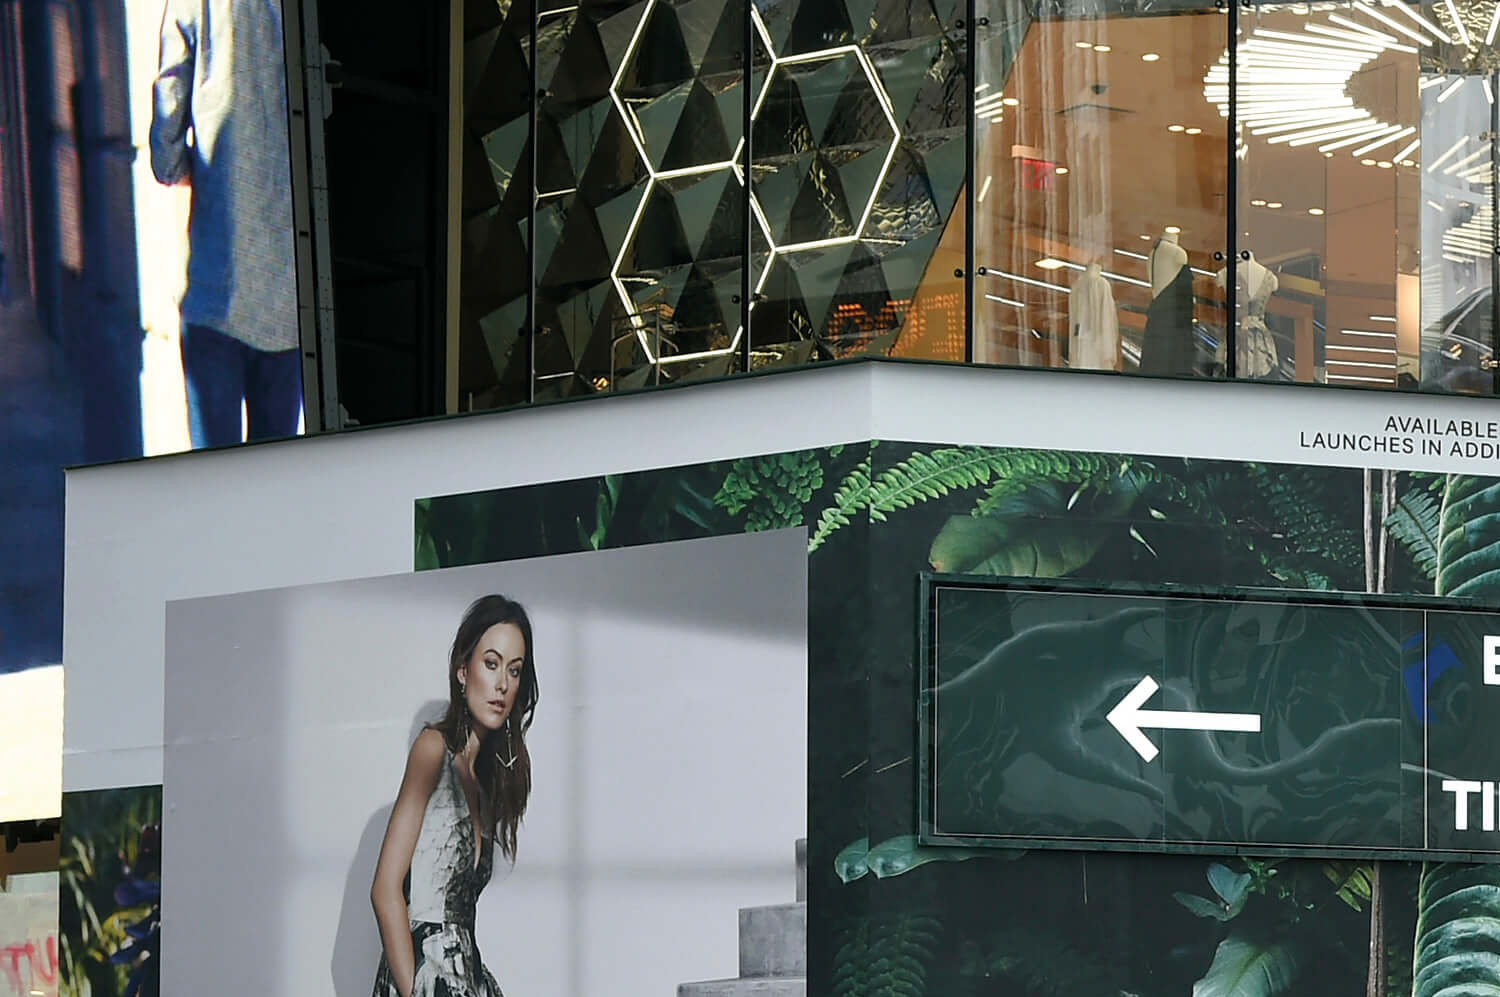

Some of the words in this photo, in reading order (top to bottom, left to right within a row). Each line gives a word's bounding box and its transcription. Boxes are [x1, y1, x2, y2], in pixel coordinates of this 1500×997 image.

[1385, 416, 1498, 438] AVAILABLE
[1300, 431, 1414, 454] LAUNCHES
[1422, 440, 1443, 456] IN
